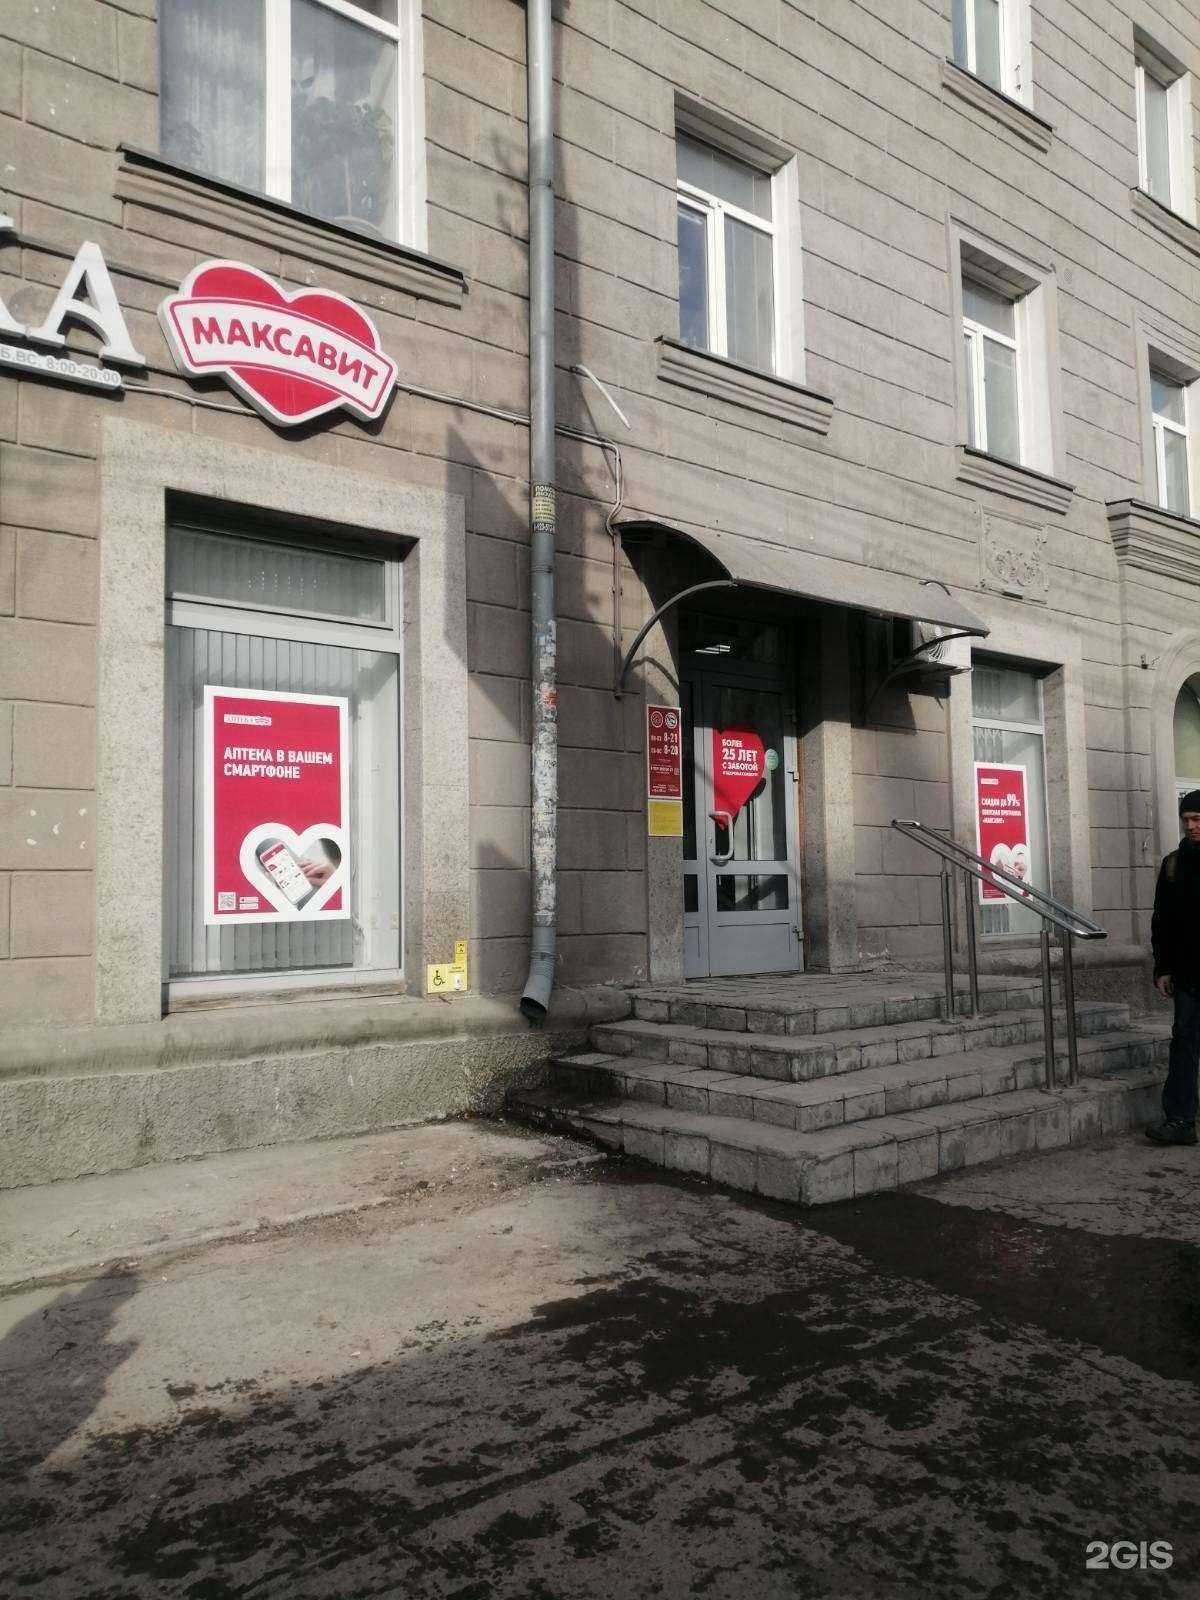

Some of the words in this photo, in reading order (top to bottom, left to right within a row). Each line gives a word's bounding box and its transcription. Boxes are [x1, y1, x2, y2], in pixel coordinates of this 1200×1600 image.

[191, 316, 380, 391] МАКСАВИТ
[46, 354, 120, 384] 8:00-20:00
[722, 738, 743, 748] БОЛЕЕ
[223, 746, 273, 762] АПТЕКА
[276, 749, 285, 762] В
[288, 750, 333, 765] ВАШЕМ
[722, 748, 736, 760] 25
[738, 749, 758, 762] ЛЕТ
[223, 763, 301, 779] СМАРТФОНЕ
[722, 761, 728, 770] С
[728, 762, 758, 771] ЗАБОТОЙ
